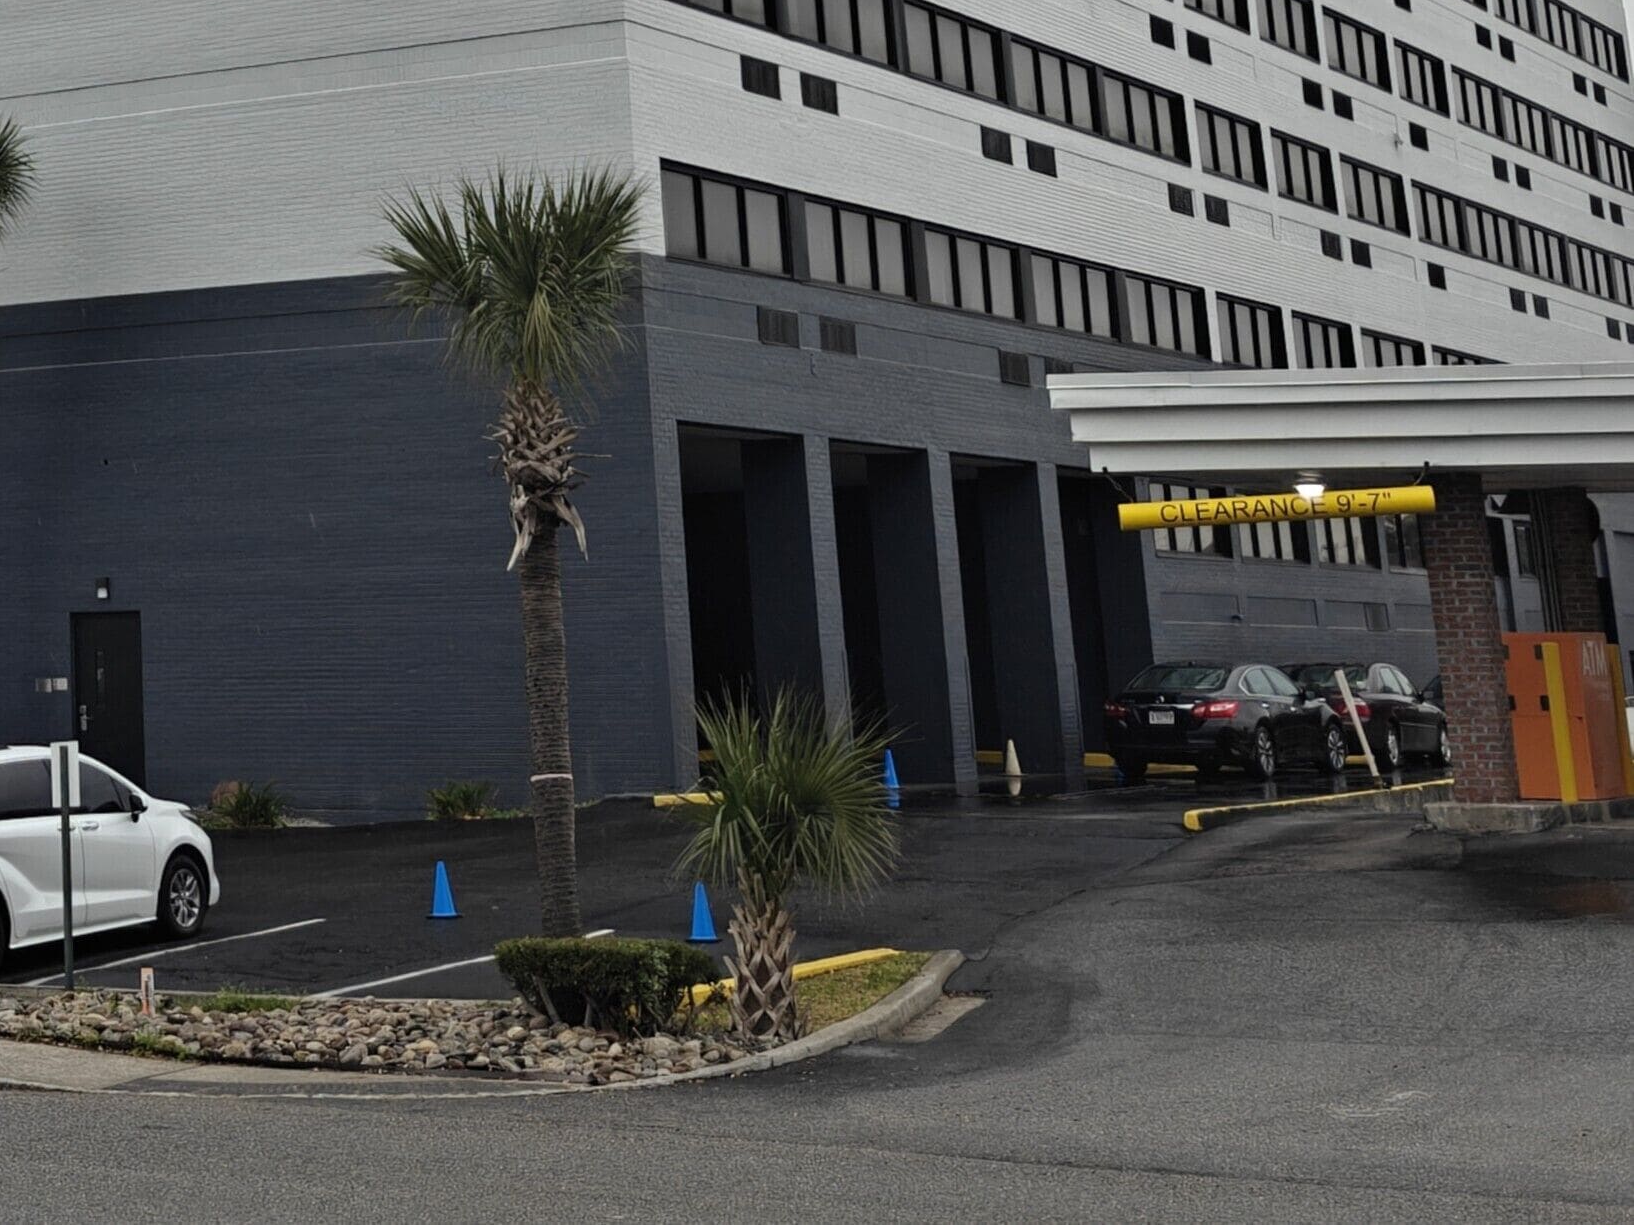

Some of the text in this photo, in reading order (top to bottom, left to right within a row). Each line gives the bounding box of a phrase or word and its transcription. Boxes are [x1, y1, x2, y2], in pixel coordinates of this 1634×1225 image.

[1160, 491, 1392, 523] CLEARANCE 9'-7"
[1582, 640, 1607, 676] ATM
